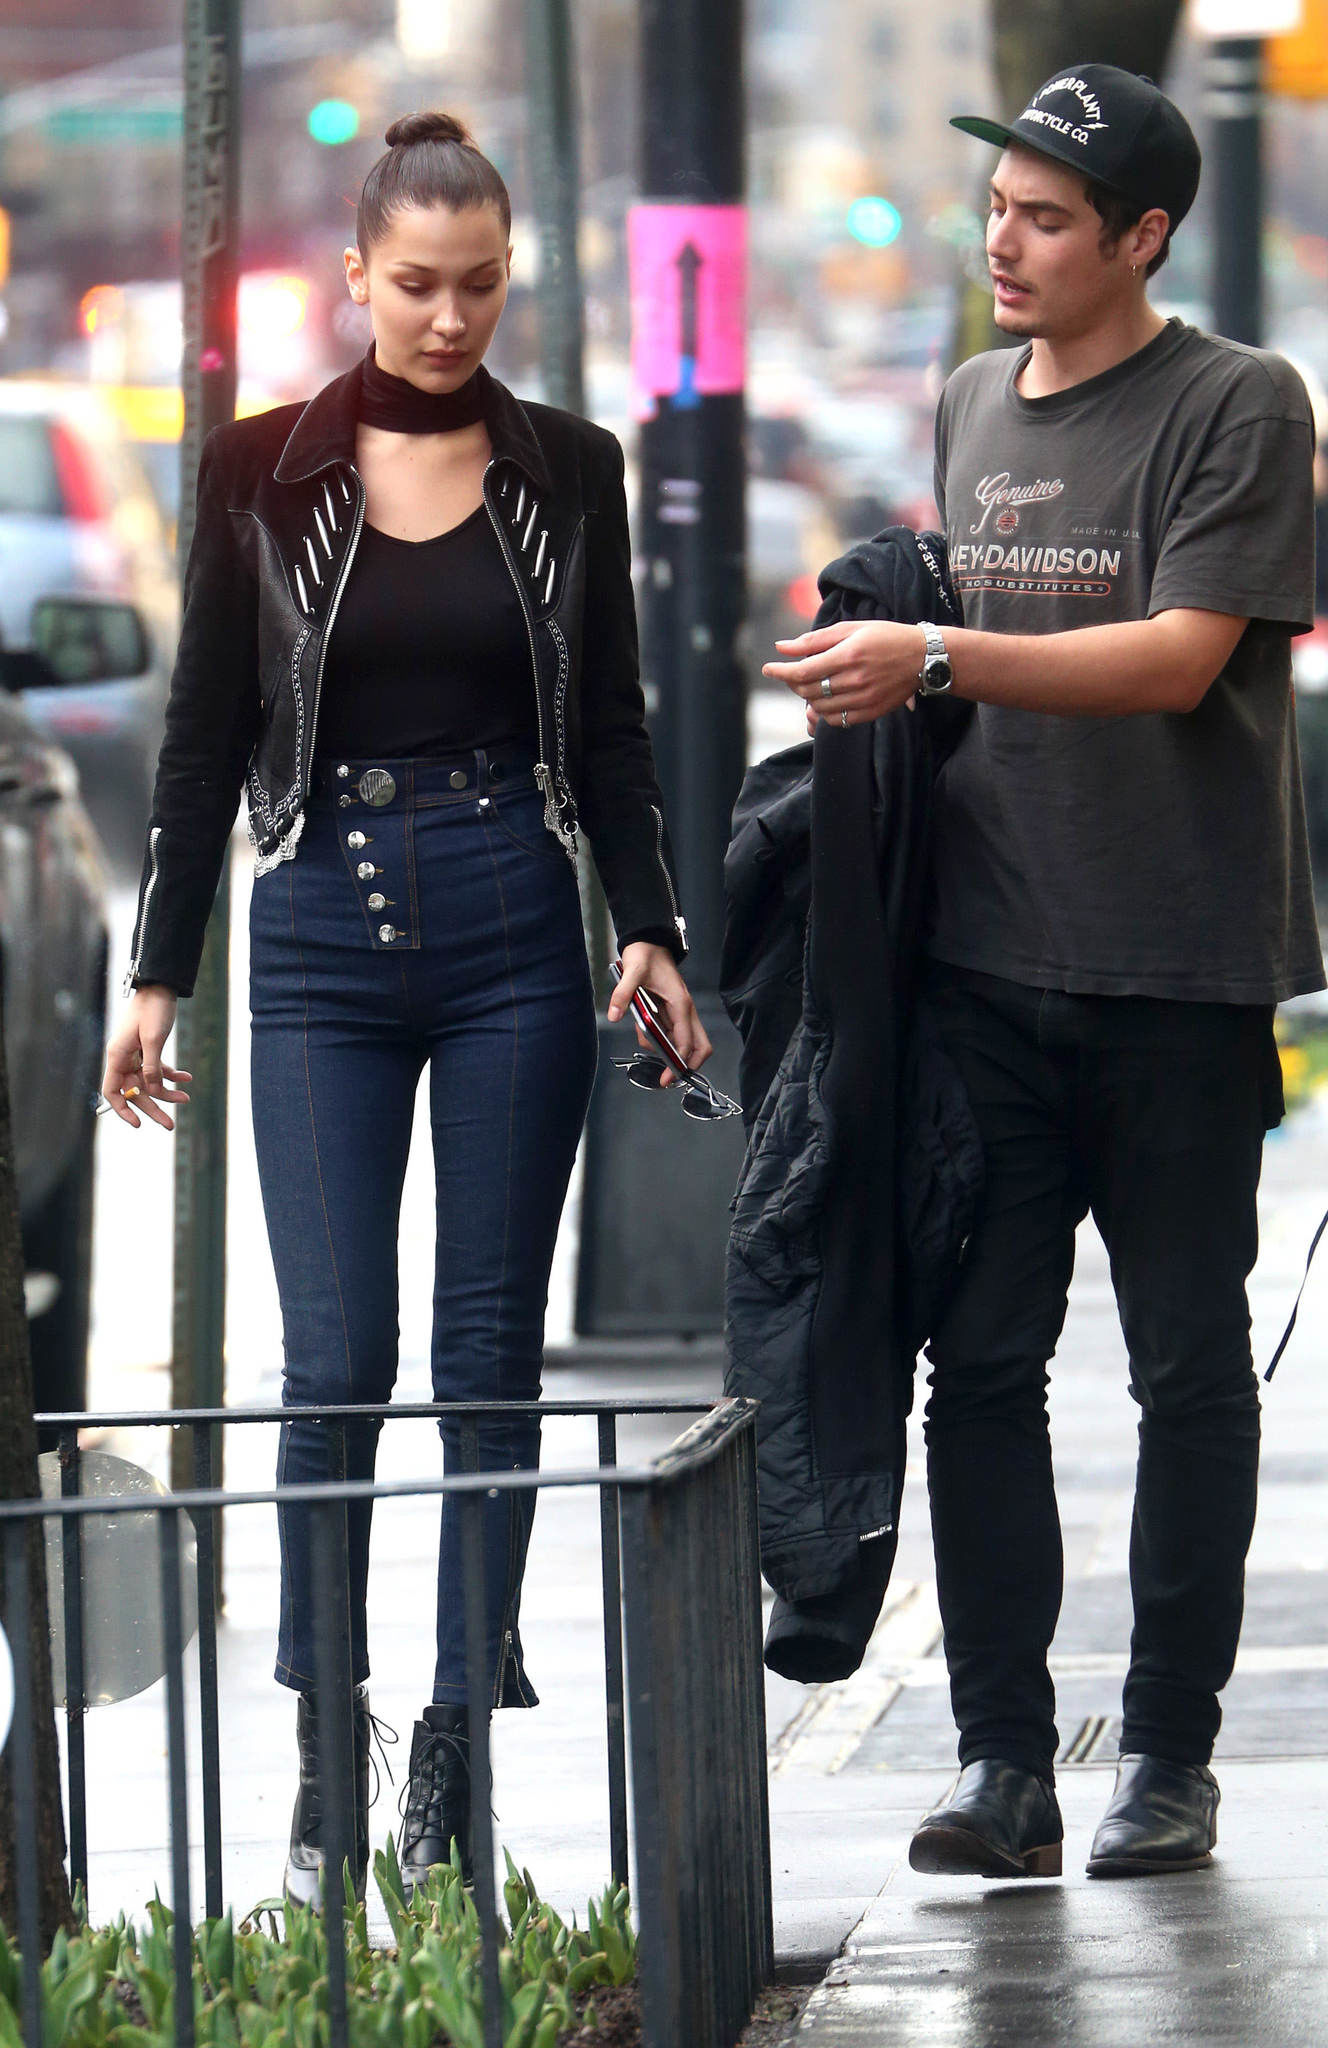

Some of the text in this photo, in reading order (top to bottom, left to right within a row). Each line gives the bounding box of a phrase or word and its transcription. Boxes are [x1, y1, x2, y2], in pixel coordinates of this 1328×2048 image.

[1071, 128, 1089, 145] CO.
[969, 472, 1064, 534] Genuine
[1071, 527, 1100, 535] MADE
[966, 579, 1092, 591] NO SUBSTITUTES
